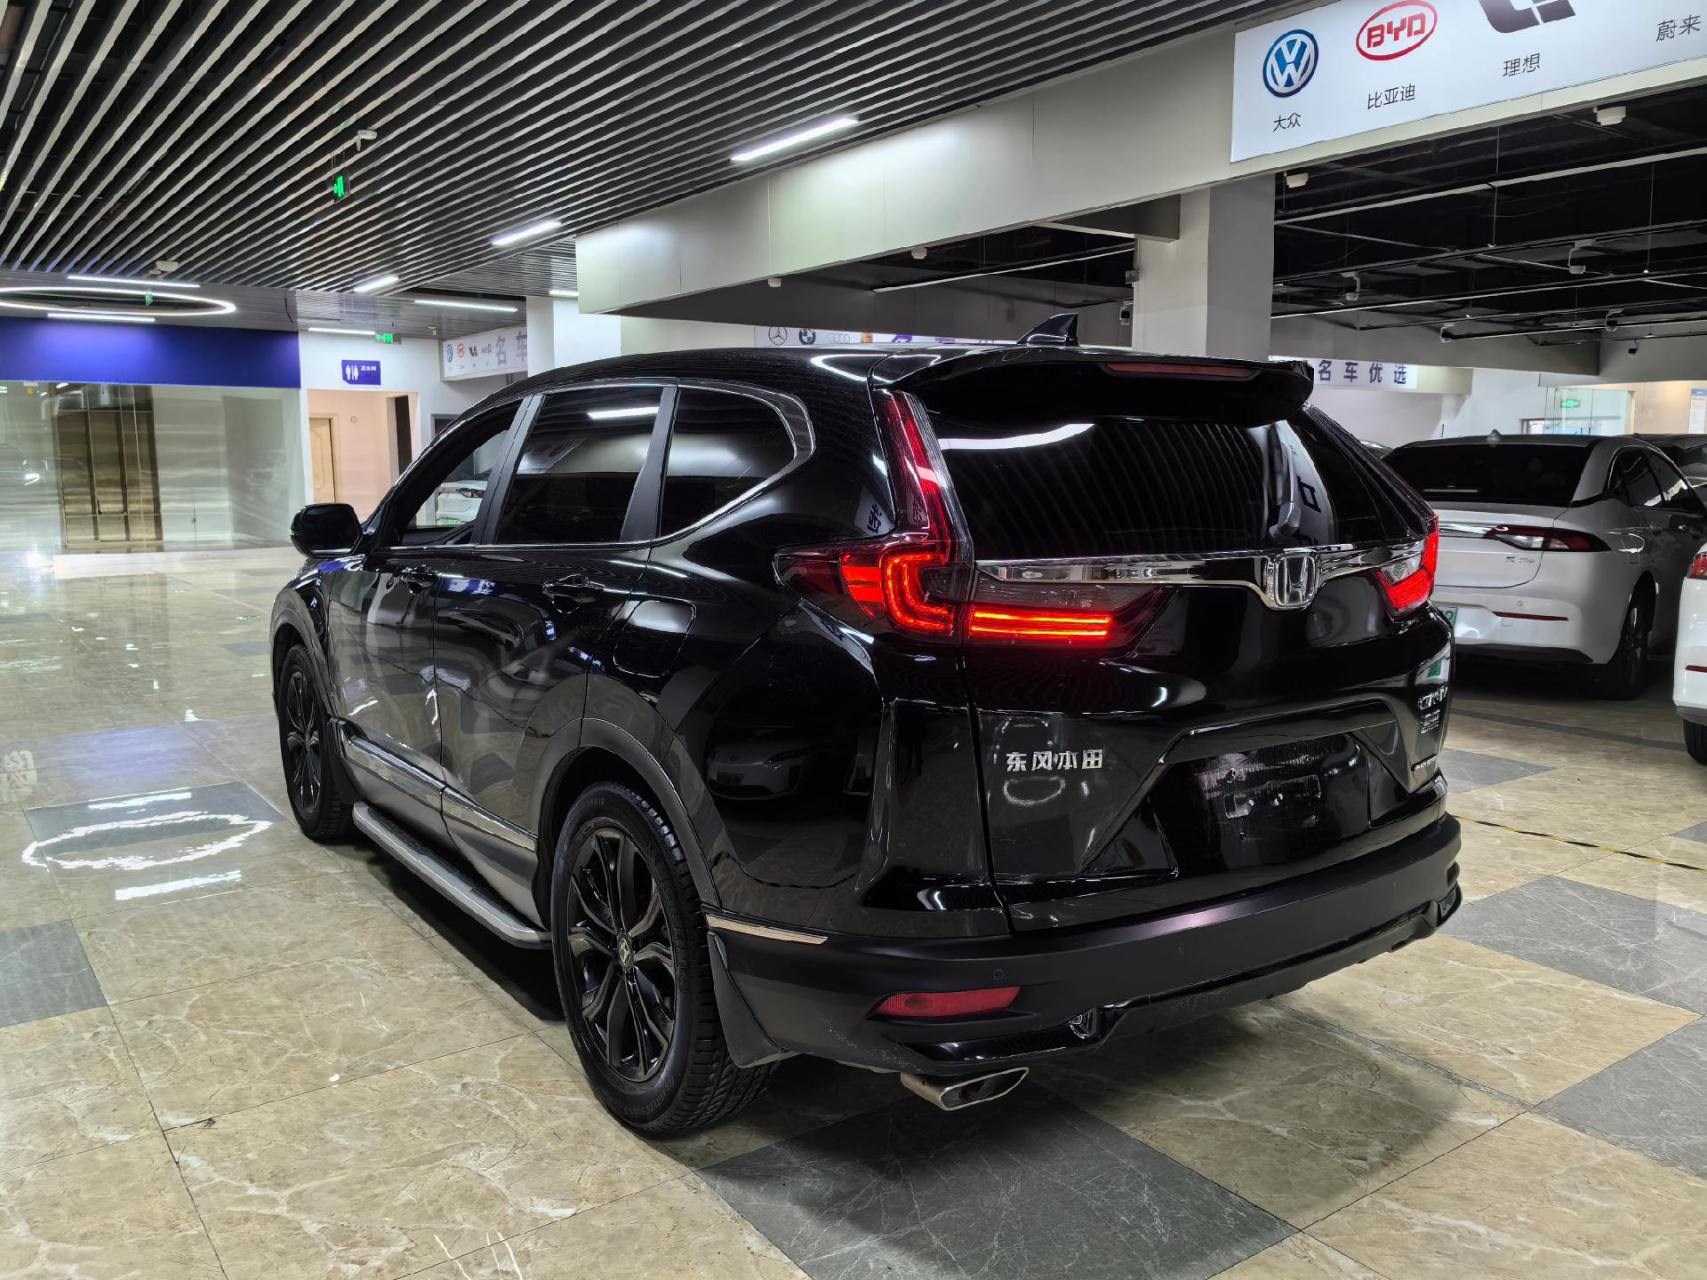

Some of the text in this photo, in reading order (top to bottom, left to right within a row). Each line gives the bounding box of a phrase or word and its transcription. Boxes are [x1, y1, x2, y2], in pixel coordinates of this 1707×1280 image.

[1367, 13, 1426, 48] BYD
[1656, 14, 1701, 42] 蔚来
[1502, 53, 1540, 77] 理想
[1367, 83, 1416, 109] 比亚迪
[1273, 112, 1301, 132] 大众
[1006, 749, 1103, 772] 东风本田
